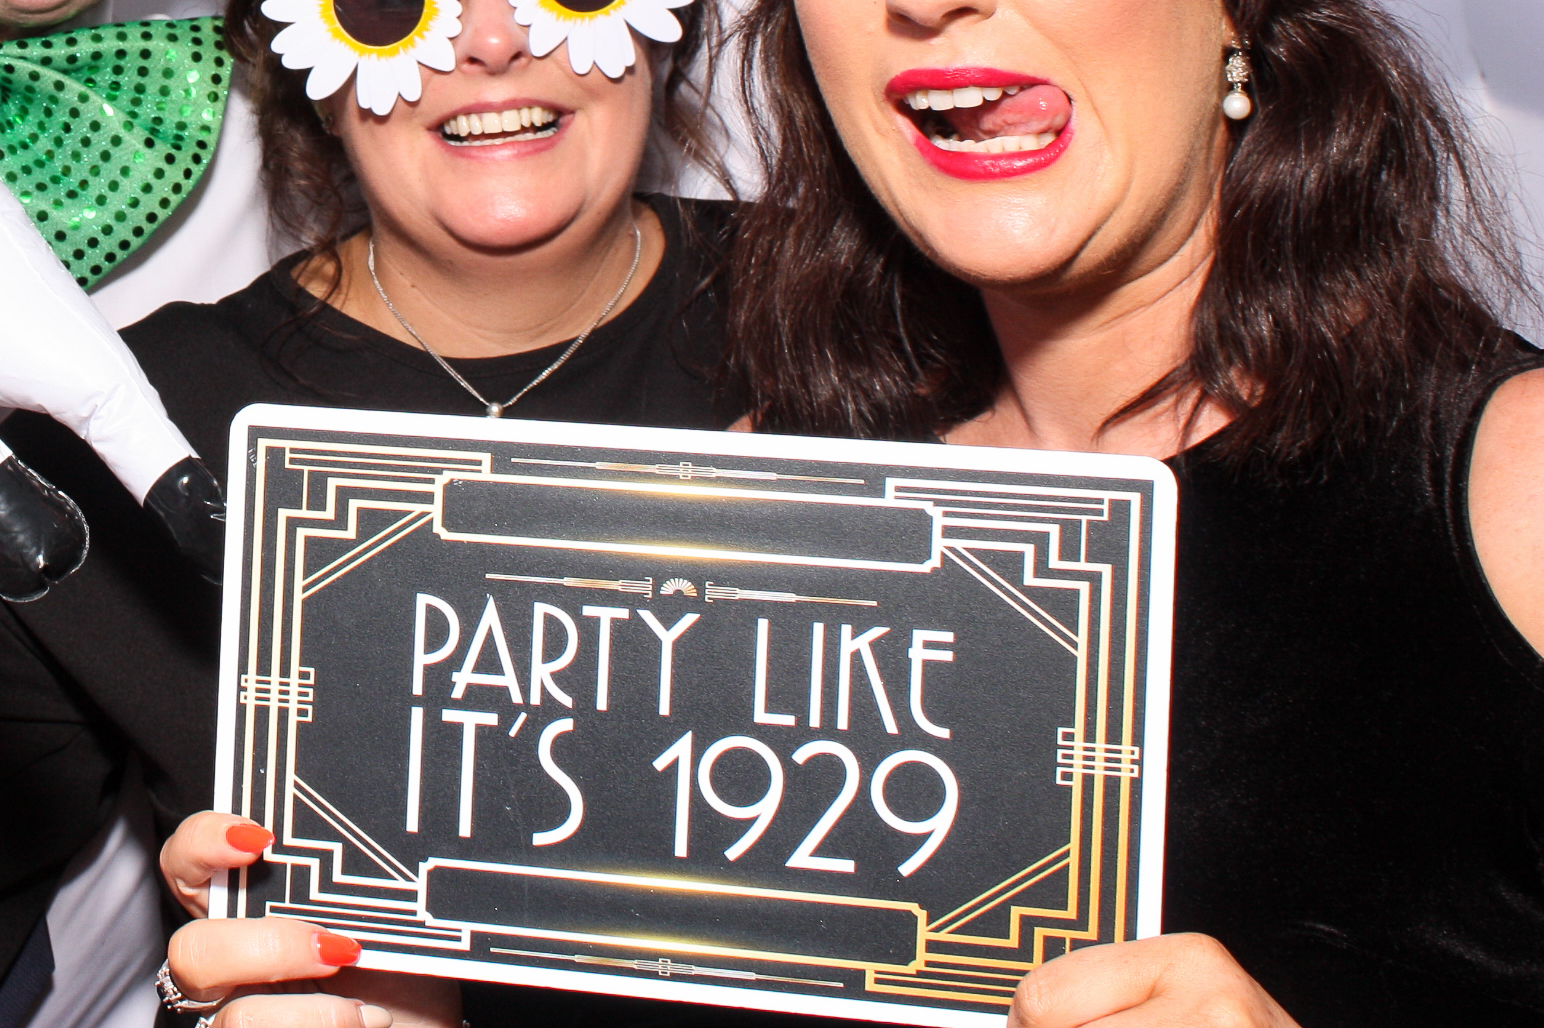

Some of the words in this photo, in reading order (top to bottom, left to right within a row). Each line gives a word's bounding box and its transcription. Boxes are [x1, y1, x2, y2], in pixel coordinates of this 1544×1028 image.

[412, 592, 702, 716] PARTY
[753, 618, 955, 740] LIKE
[406, 706, 586, 847] IT'S
[652, 730, 961, 878] 1929
